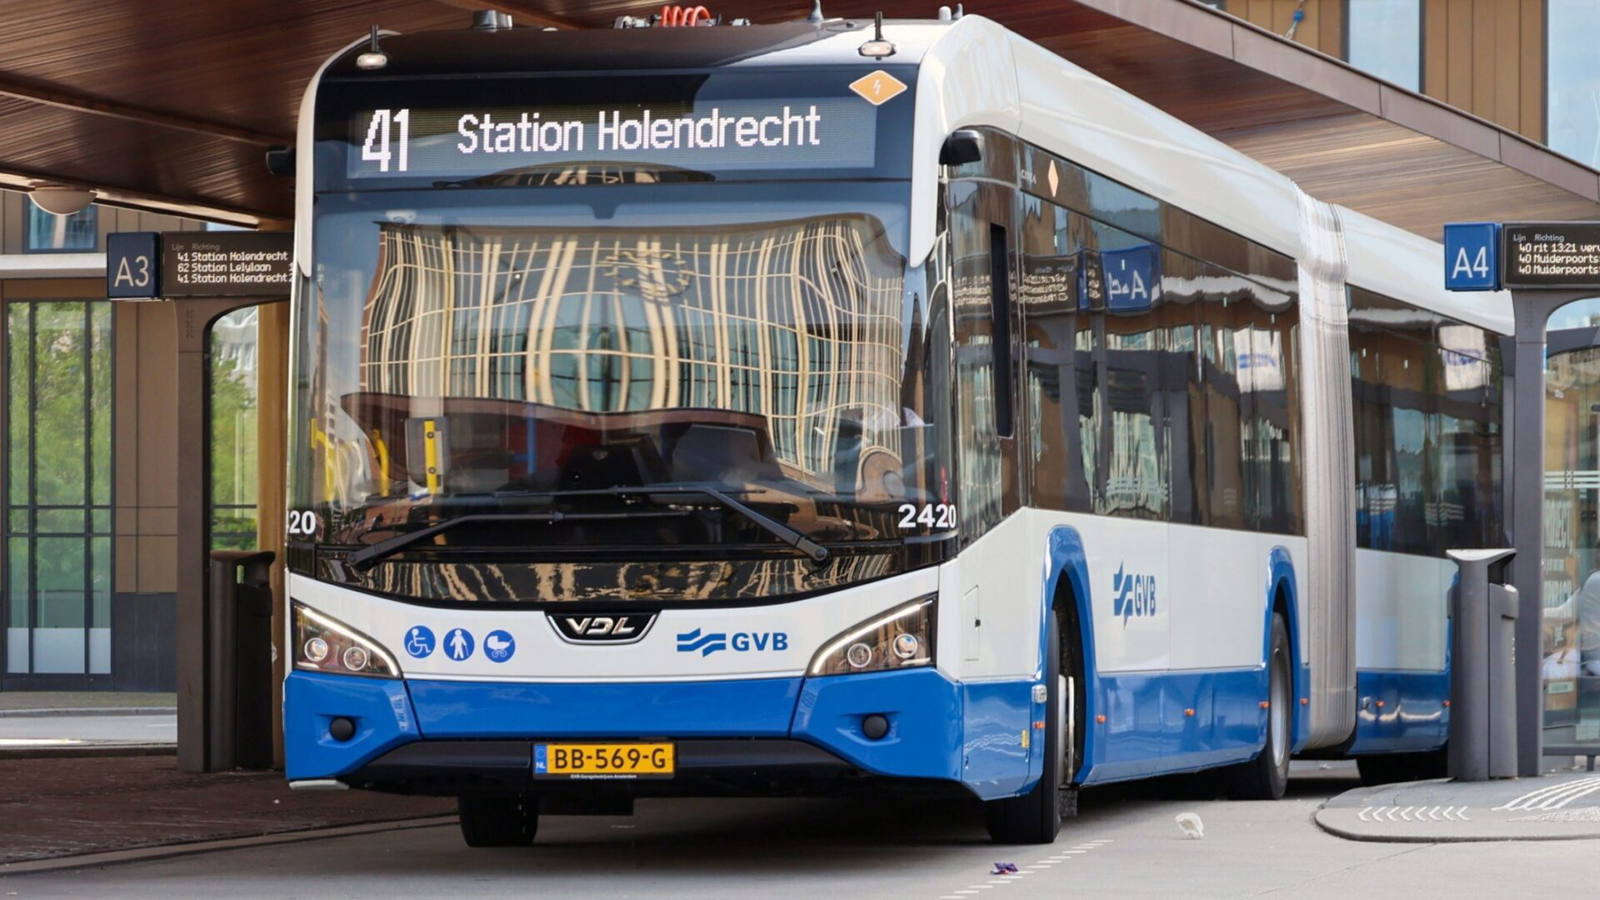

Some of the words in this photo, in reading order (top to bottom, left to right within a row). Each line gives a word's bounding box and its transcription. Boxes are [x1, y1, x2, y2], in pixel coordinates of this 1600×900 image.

[361, 108, 410, 172] 41
[457, 112, 583, 153] Station
[598, 105, 821, 151] Holendrecht
[1513, 234, 1526, 242] Lijn
[1534, 234, 1565, 242] Richting
[177, 252, 189, 261] 41
[191, 252, 227, 261] Station
[229, 251, 288, 261] Holendrecht
[1519, 243, 1532, 252] 40
[1534, 243, 1548, 252] rit
[177, 263, 190, 272] 62
[191, 263, 227, 272] Station
[229, 263, 272, 273] Lelylaan
[1452, 246, 1489, 279] A4
[1519, 254, 1532, 263] 40
[1533, 254, 1600, 264] Muiderpoorts
[114, 255, 150, 288] A3
[177, 274, 189, 283] 41
[191, 274, 227, 283] Station
[229, 273, 287, 283] Holendrecht
[1519, 265, 1532, 274] 40
[1533, 265, 1600, 275] Muiderpoorts
[287, 510, 316, 534] 20
[898, 503, 957, 528] 2420
[1134, 574, 1156, 616] GVB
[566, 617, 635, 635] VDL
[731, 632, 788, 651] GVB
[554, 748, 666, 769] BB-569-G
